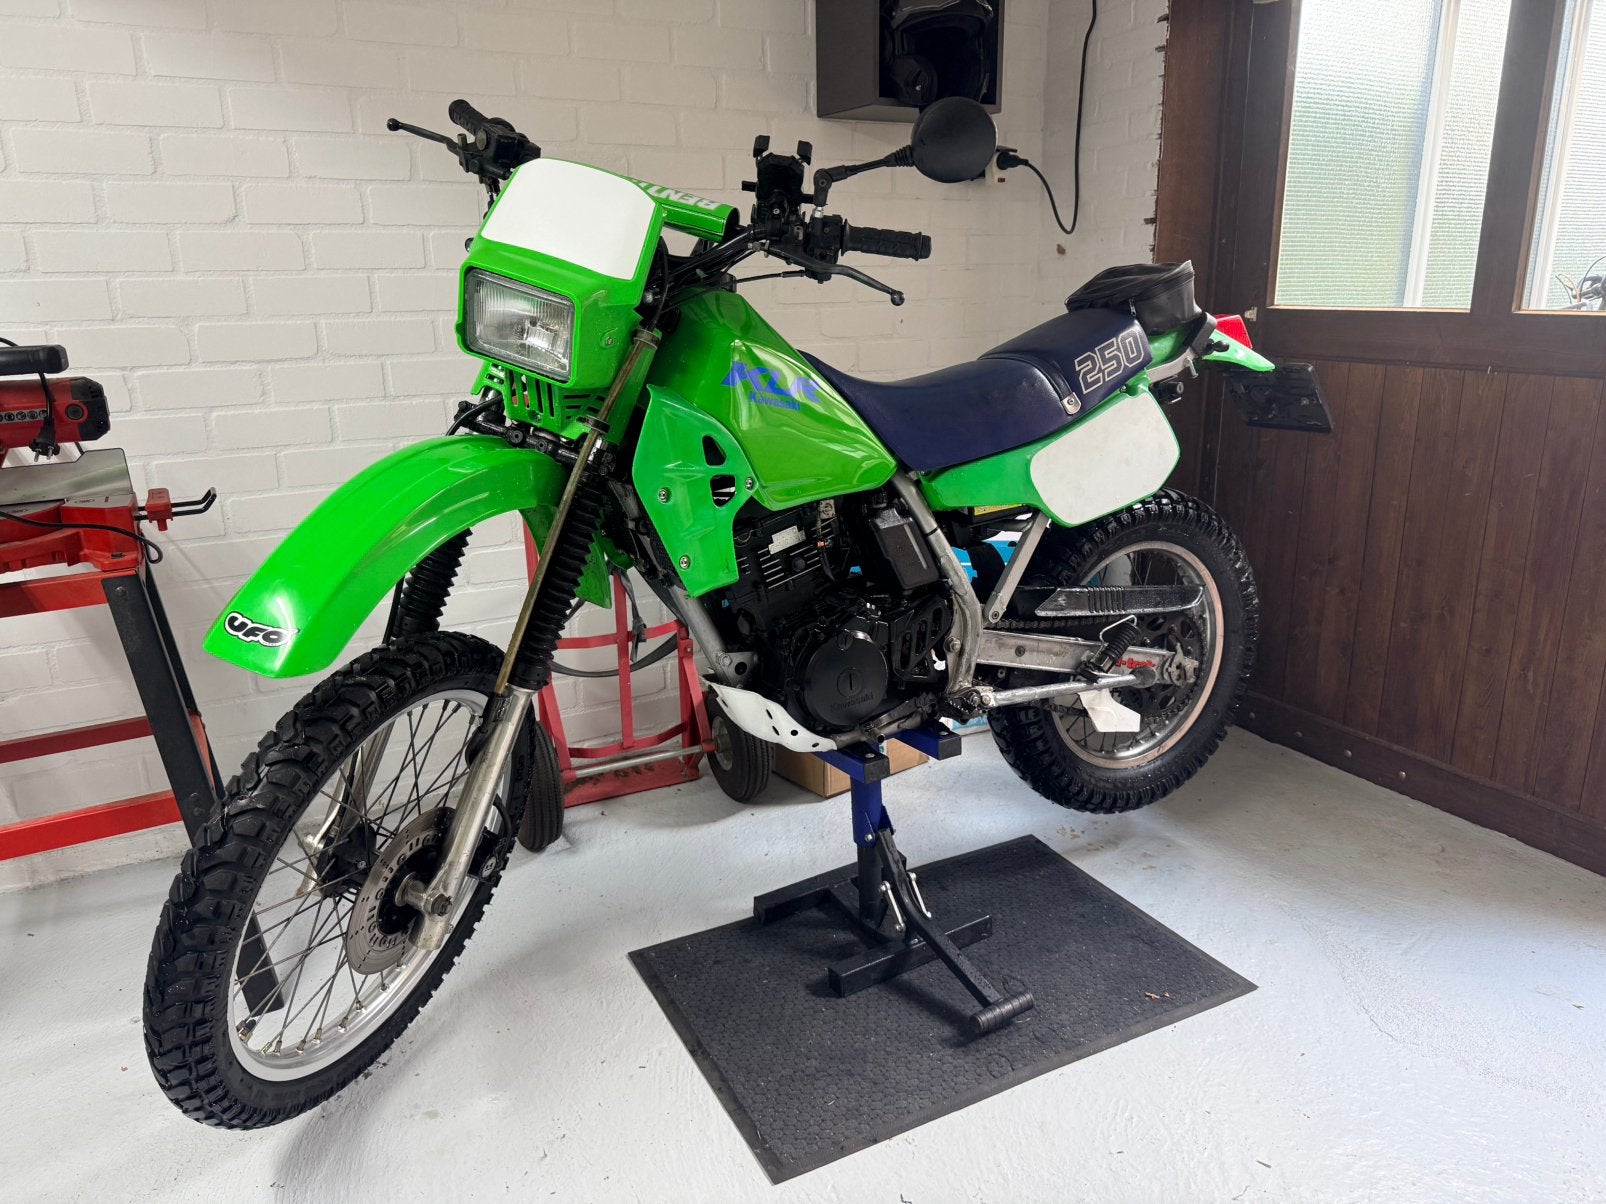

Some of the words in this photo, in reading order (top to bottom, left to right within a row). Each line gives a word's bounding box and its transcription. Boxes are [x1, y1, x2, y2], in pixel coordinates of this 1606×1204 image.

[1075, 328, 1144, 394] 250
[750, 391, 801, 411] Kawasaki
[227, 615, 289, 644] UFO
